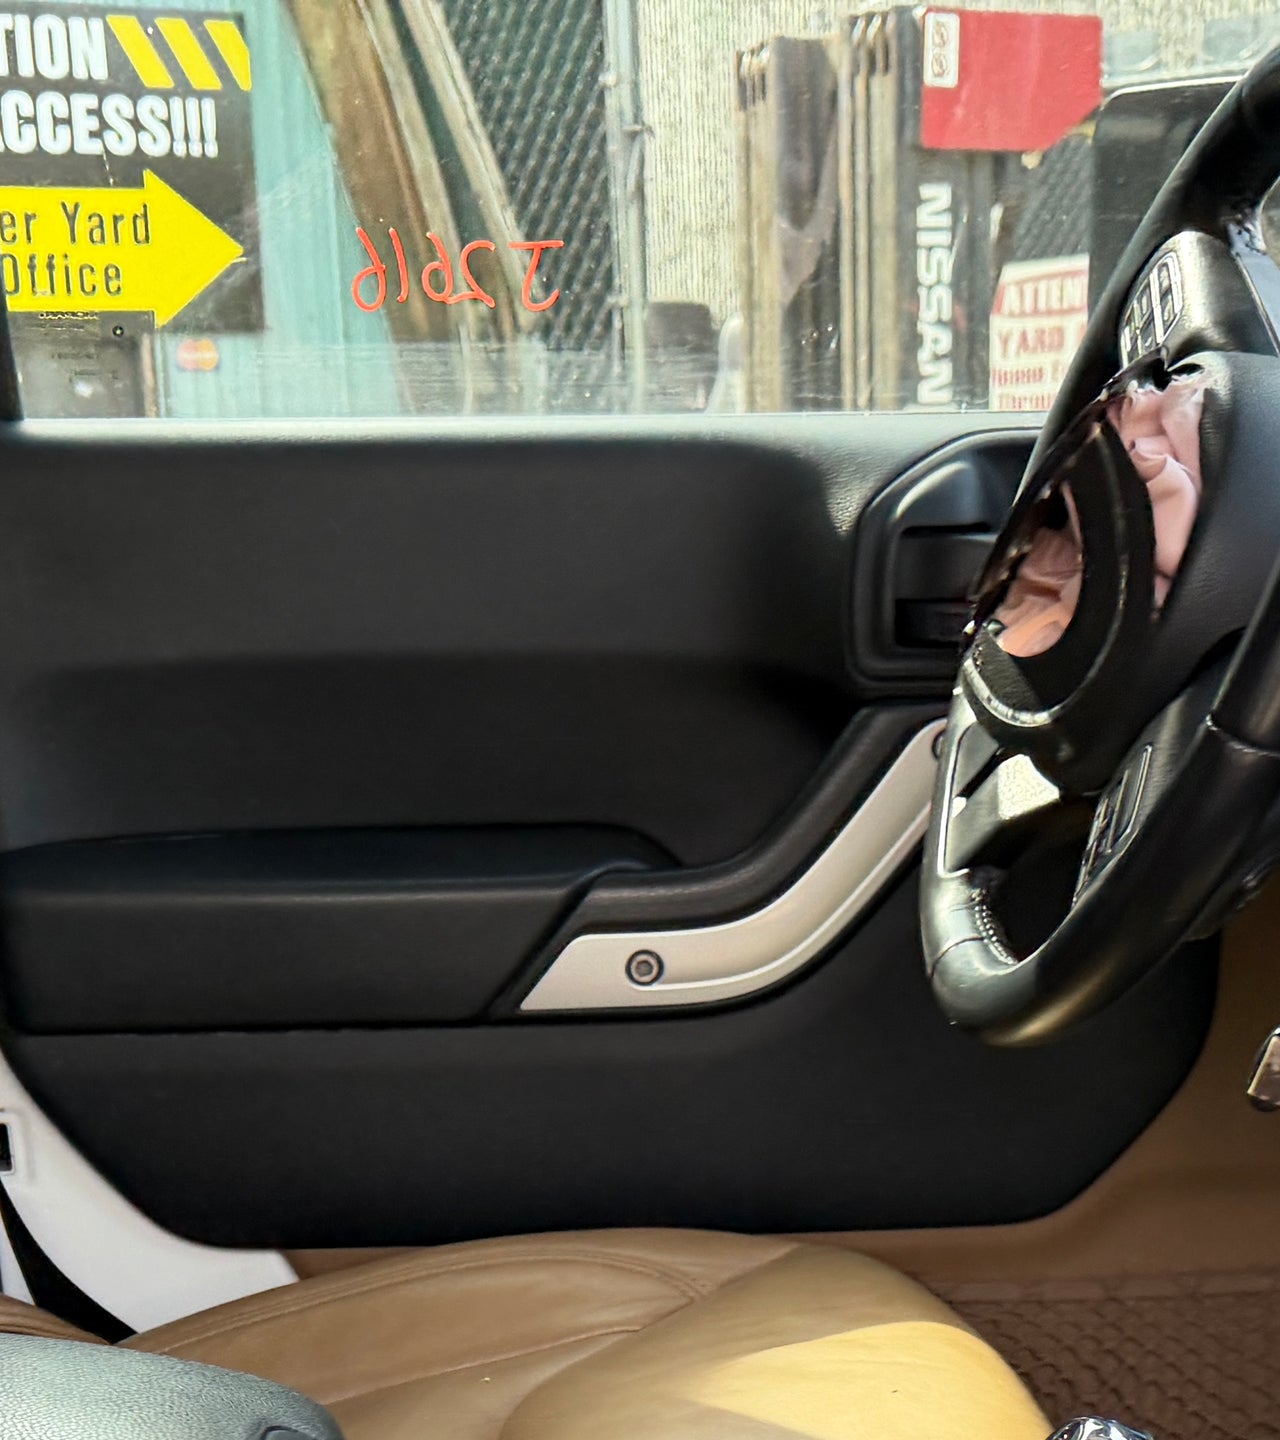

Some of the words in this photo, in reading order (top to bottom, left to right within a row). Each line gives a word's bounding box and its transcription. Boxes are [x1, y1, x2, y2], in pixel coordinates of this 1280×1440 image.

[61, 201, 151, 245] Yard
[1, 253, 122, 296] Office
[916, 183, 953, 405] NISSAN
